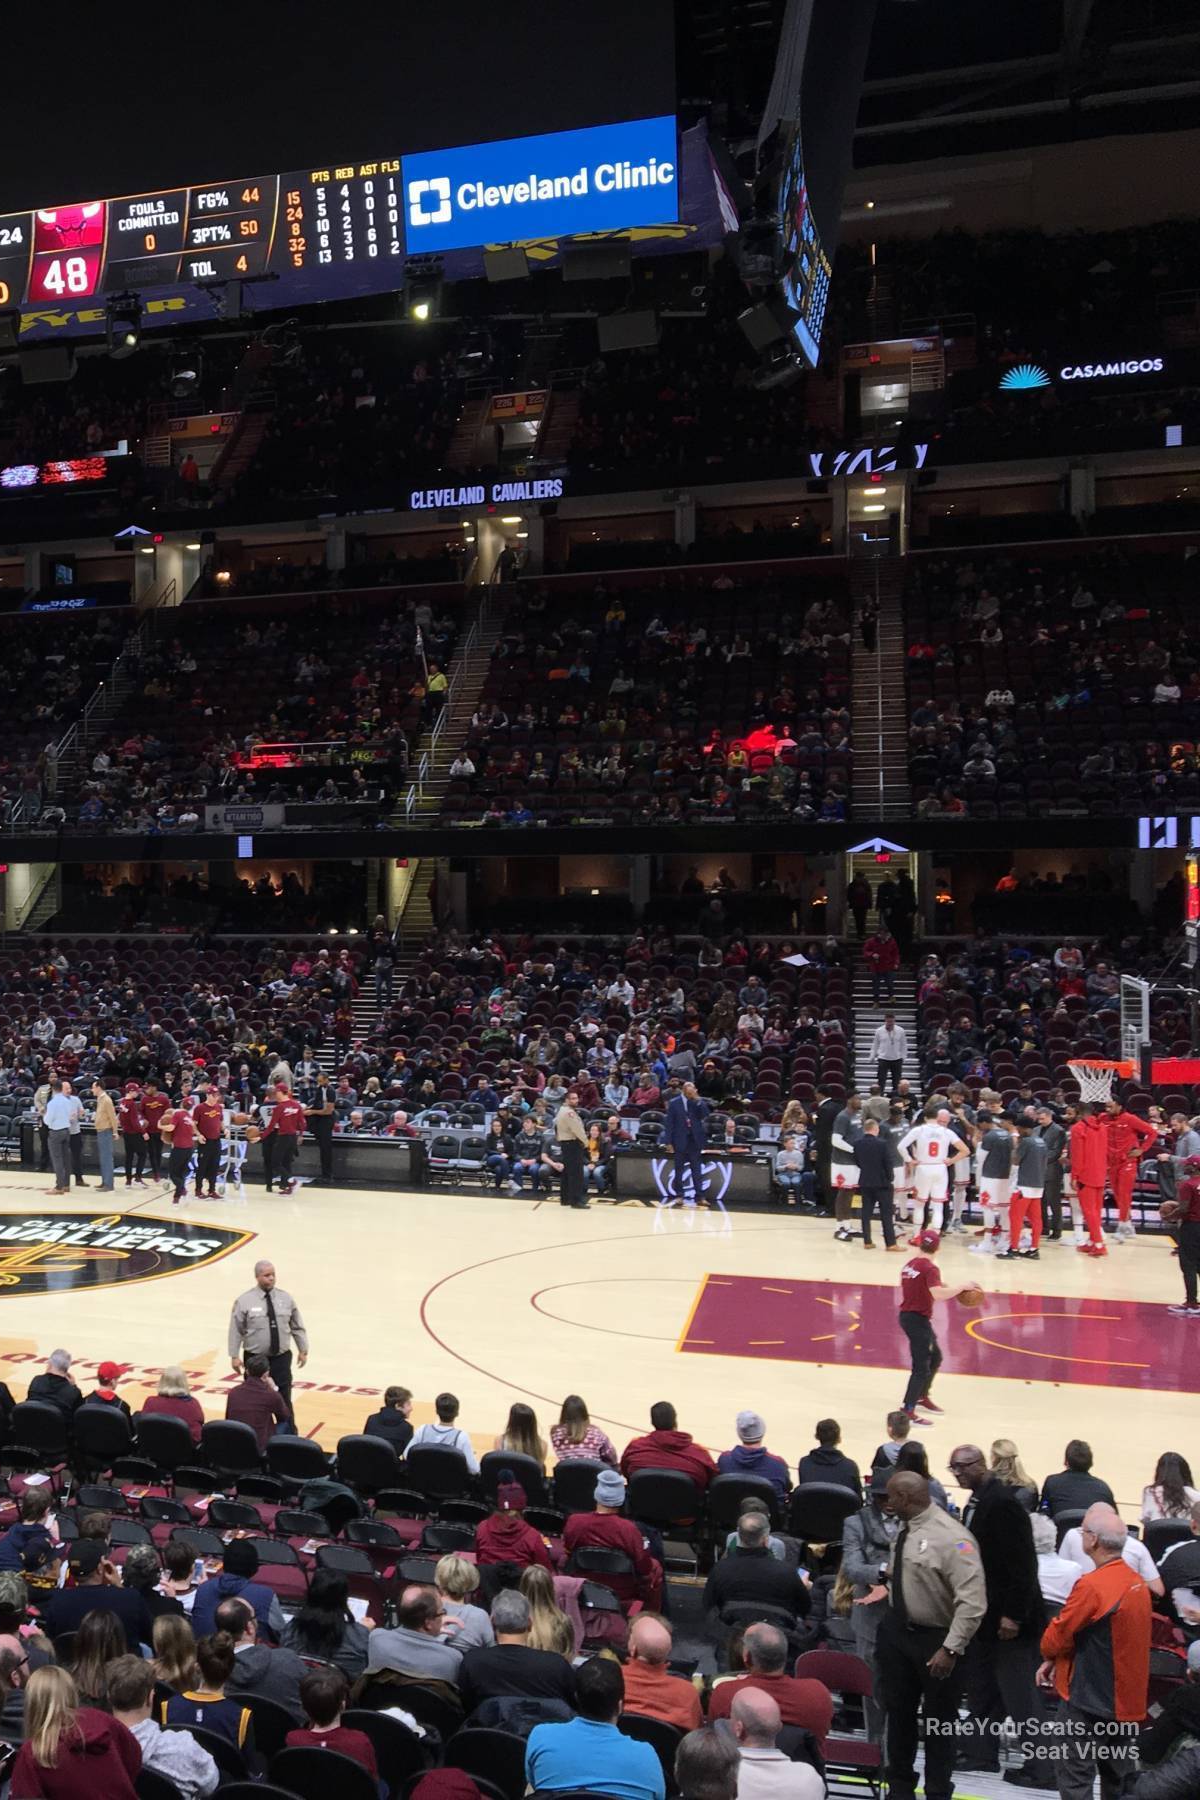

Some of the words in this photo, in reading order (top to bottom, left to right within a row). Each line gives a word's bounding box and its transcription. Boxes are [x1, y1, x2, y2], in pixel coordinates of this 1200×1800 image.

[312, 171, 330, 183] PTS
[335, 168, 354, 179] REB
[360, 164, 377, 176] AST
[382, 161, 399, 172] FLS
[287, 192, 300, 205] 15
[316, 188, 325, 200] 5
[340, 184, 349, 197] 4
[365, 181, 373, 194] 0
[458, 168, 587, 210] Cleveland
[594, 158, 674, 191] Clinic
[129, 200, 165, 217] FOULS
[198, 191, 228, 209] FG%
[242, 188, 259, 203] 44
[286, 207, 303, 220] 24
[318, 203, 326, 216] 5
[341, 200, 350, 213] 4
[366, 197, 374, 210] 0
[388, 194, 396, 207] 0
[118, 212, 179, 231] COMMITTED
[192, 224, 231, 244] 3PT%
[240, 220, 258, 235] 50
[292, 223, 300, 235] 8
[317, 219, 330, 232] 10
[343, 216, 351, 229] 2
[389, 210, 398, 222] 0
[0, 227, 22, 245] 24
[145, 234, 156, 250] 0
[289, 238, 305, 251] 32
[320, 234, 328, 247] 6
[344, 231, 352, 244] 3
[368, 228, 376, 241] 6
[294, 254, 302, 266] 5
[319, 250, 332, 263] 13
[345, 247, 353, 260] 3
[369, 244, 378, 257] 0
[391, 241, 400, 254] 2
[43, 257, 88, 294] 48
[190, 260, 216, 277] TOL
[237, 256, 247, 272] 4
[1060, 358, 1163, 380] CASAMIGOS
[411, 485, 485, 509] CLEVELAND
[492, 478, 563, 502] CAVALIERS
[929, 1142, 938, 1157] 8
[22, 1219, 166, 1237] CLEVELAND
[219, 1373, 383, 1395] Lans
